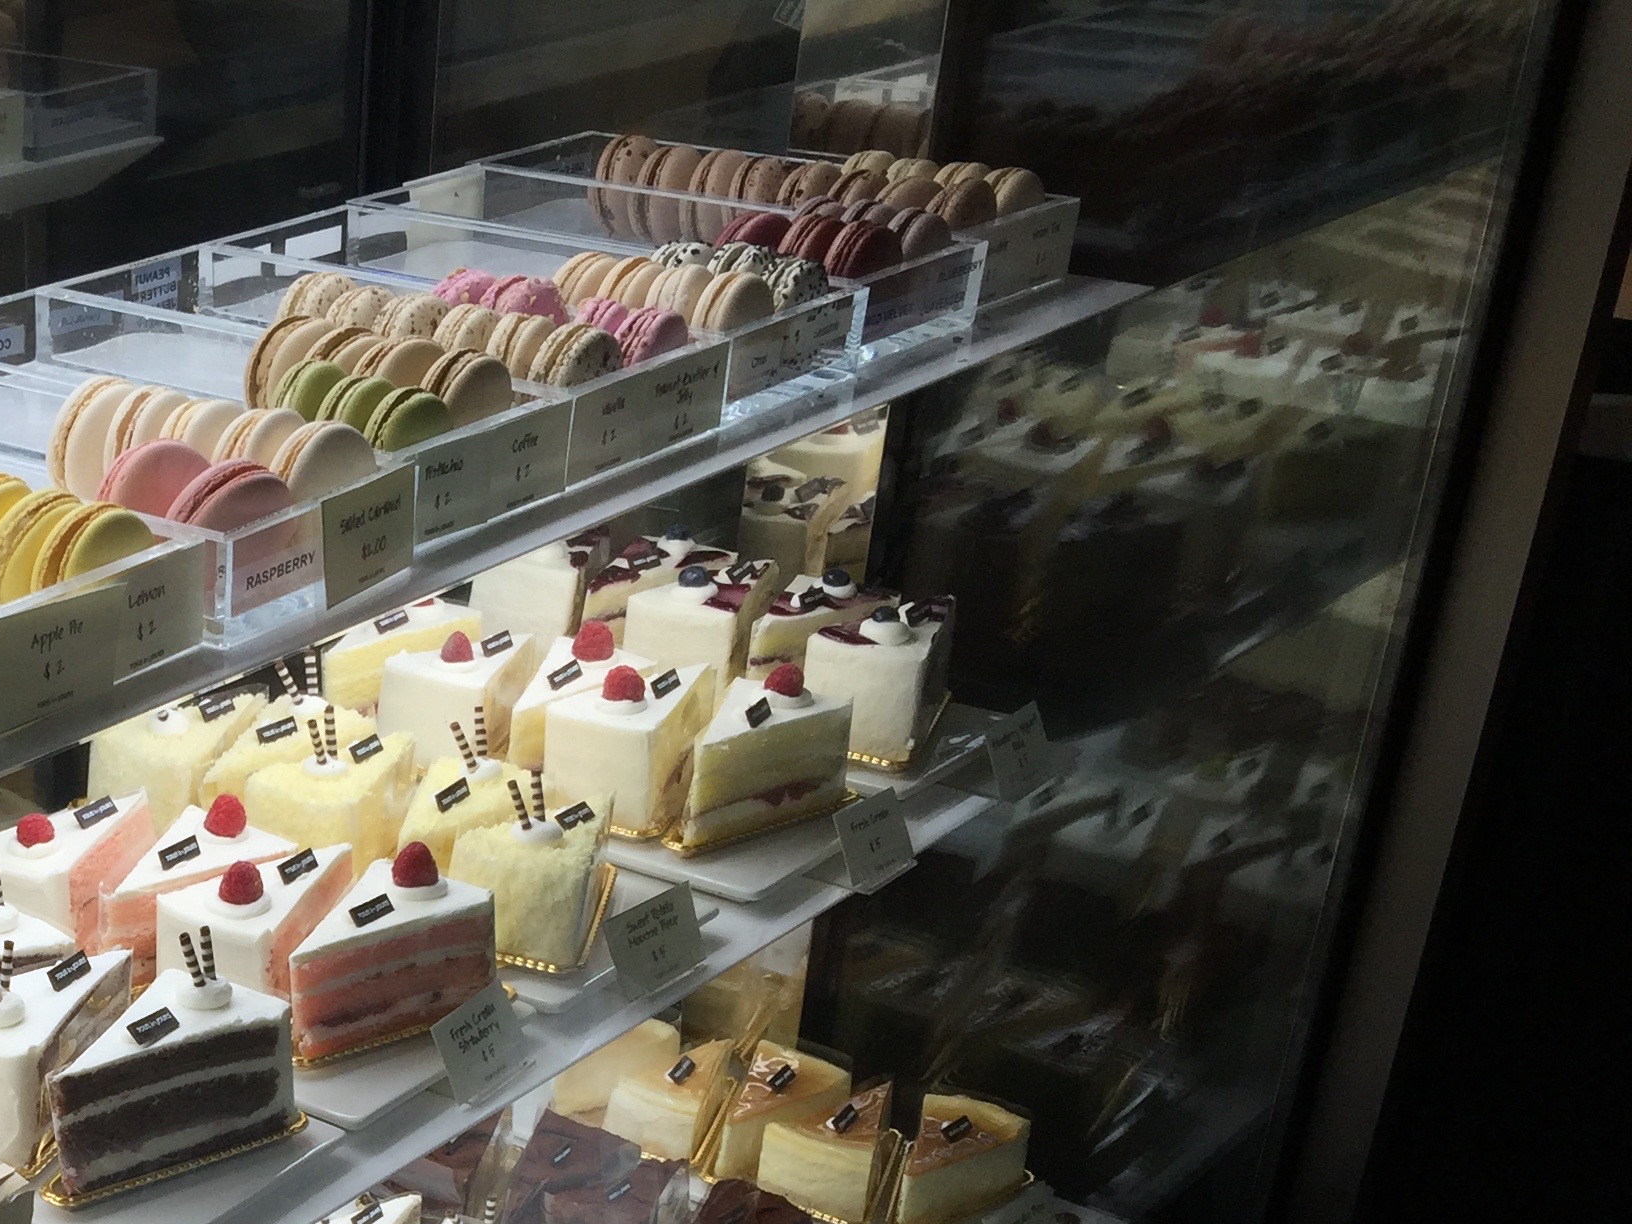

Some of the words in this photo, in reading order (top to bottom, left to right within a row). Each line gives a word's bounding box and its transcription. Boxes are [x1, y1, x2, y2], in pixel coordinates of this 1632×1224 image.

[246, 551, 316, 591] RASPBERRY
[30, 624, 64, 654] Apple
[148, 620, 157, 635] 2
[57, 659, 65, 675] 2
